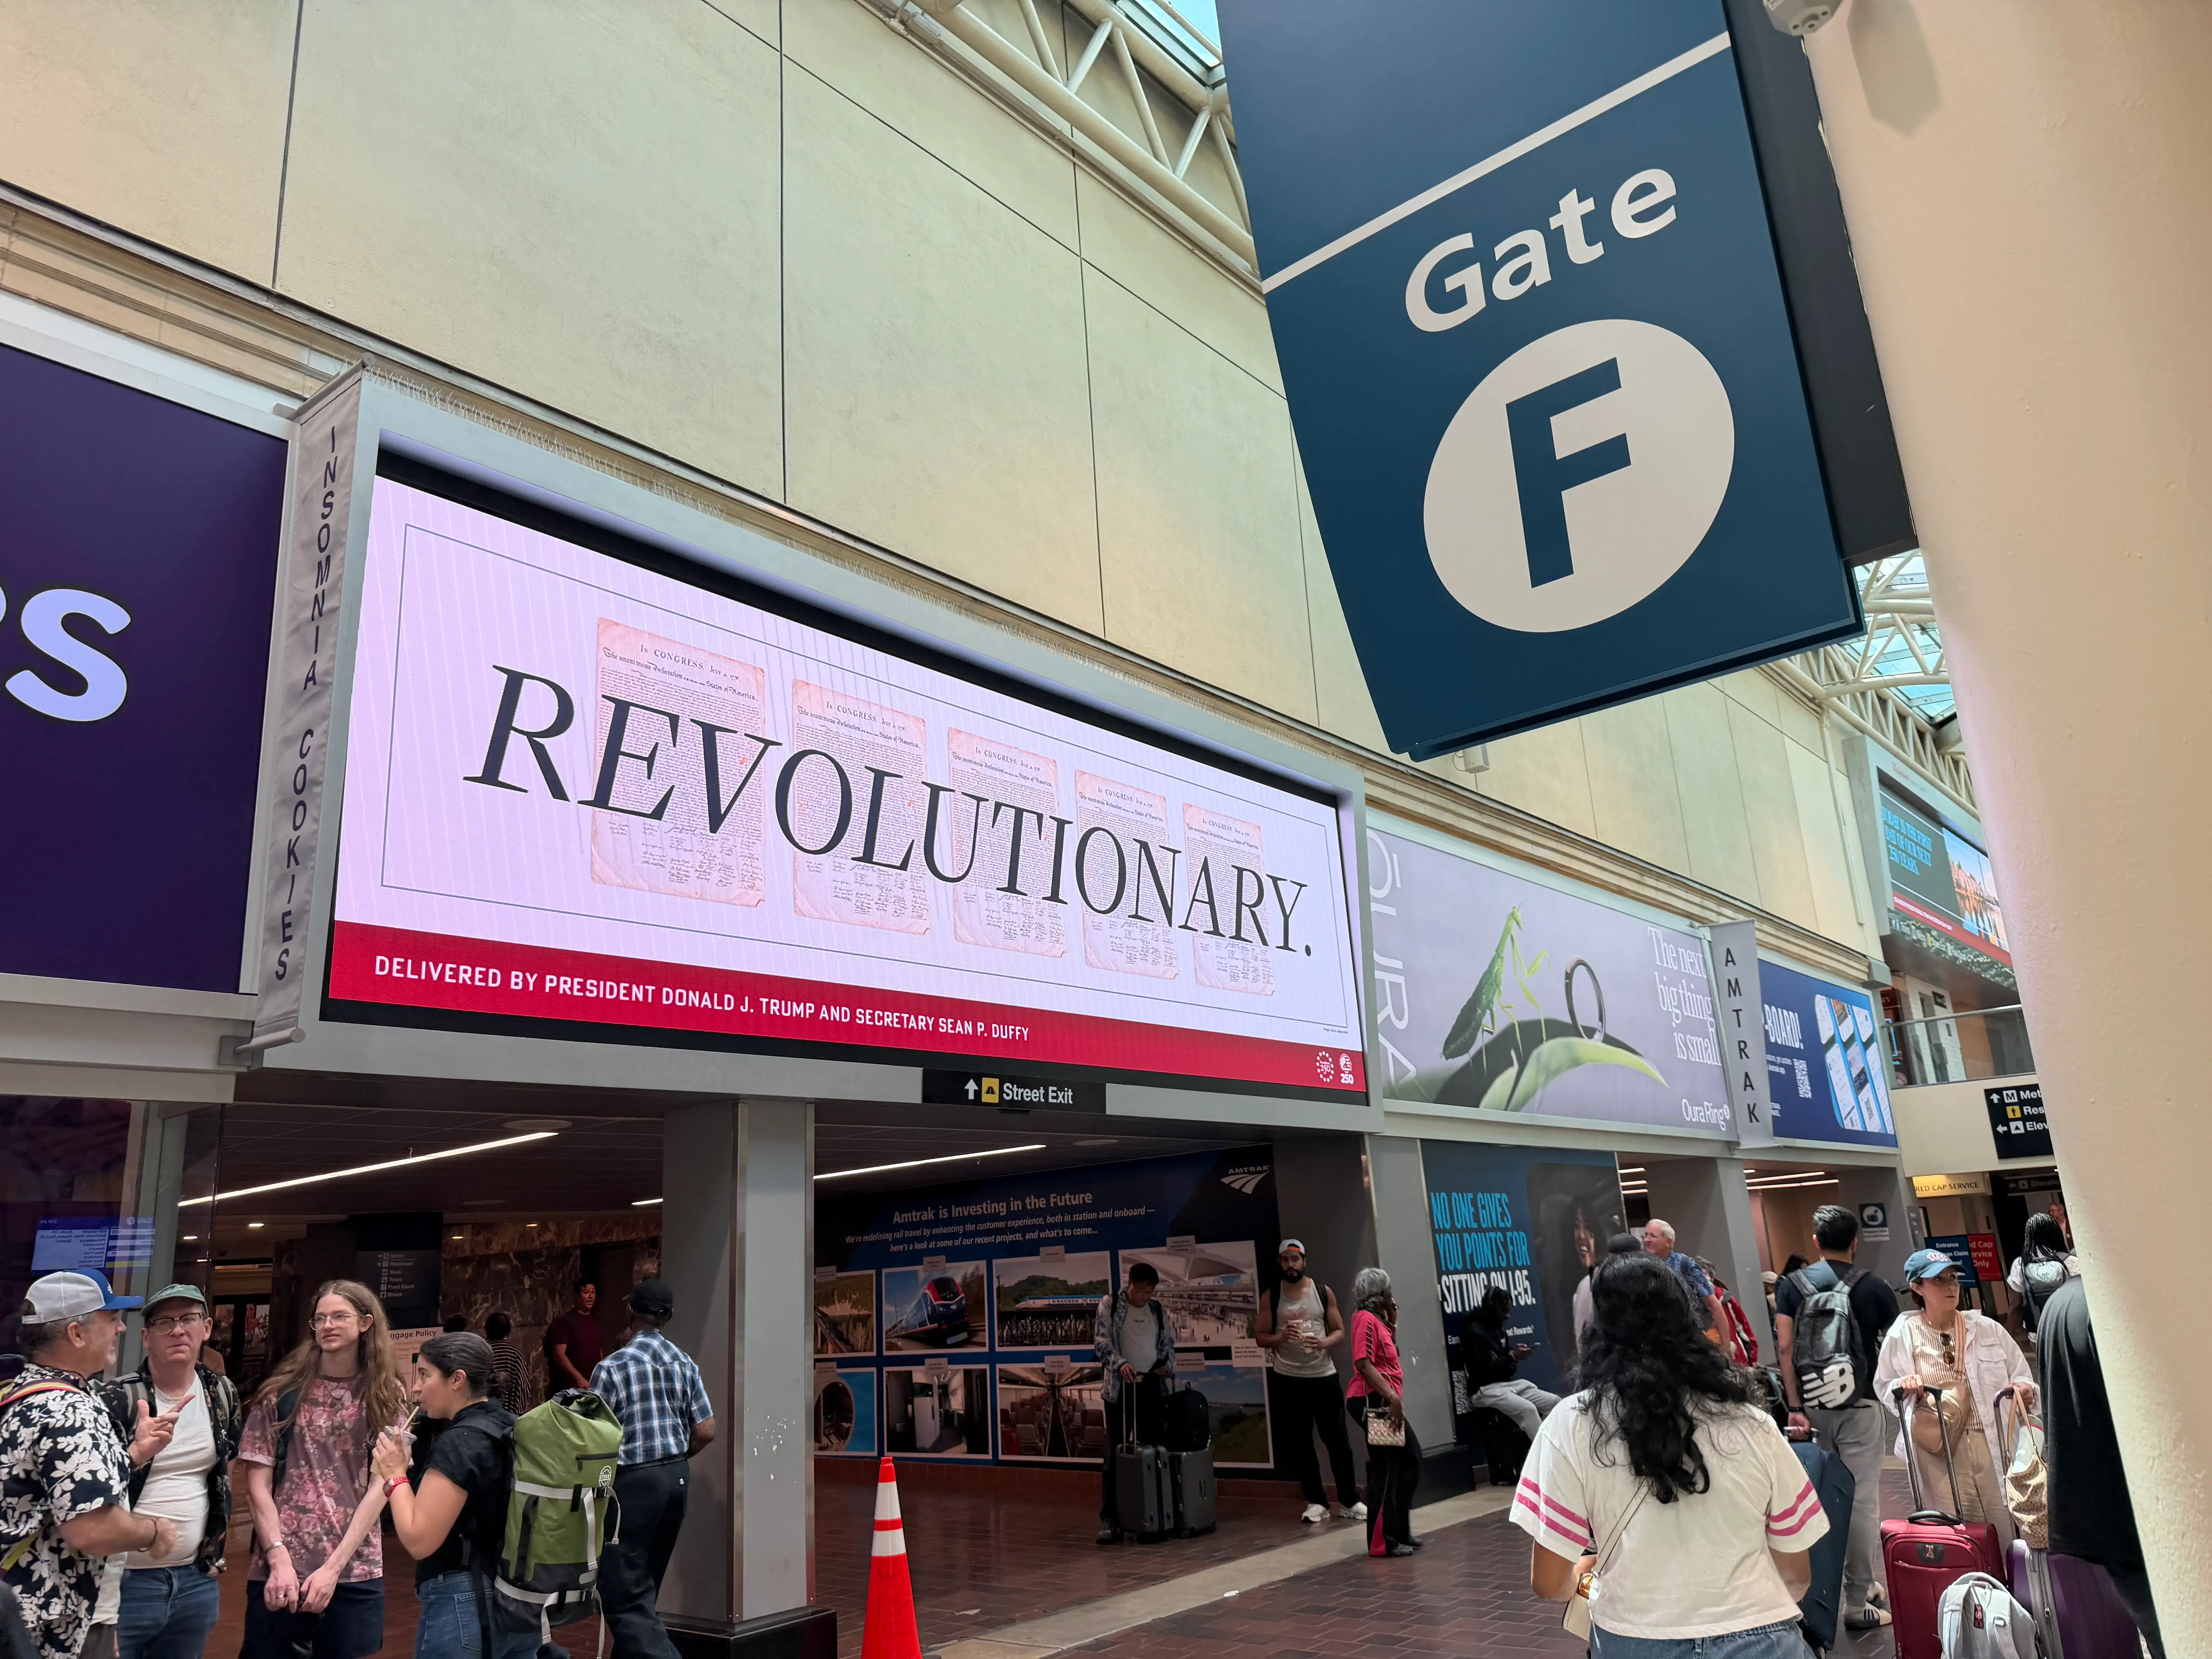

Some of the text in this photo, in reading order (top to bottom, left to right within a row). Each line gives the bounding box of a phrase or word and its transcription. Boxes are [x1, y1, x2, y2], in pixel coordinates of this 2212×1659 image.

[1405, 168, 1677, 333] Gate
[1505, 357, 1632, 589] F
[303, 425, 337, 691] INSOMNIA
[464, 666, 1312, 957] REVOLUTIONARY.
[274, 728, 314, 981] COOKIES
[1648, 926, 1707, 979] The next
[375, 955, 1029, 1041] DELIVERED BY PRESIDENT DONALD J. TRUMP AND SECRETARY SEAN P. DUFFY
[1654, 971, 1716, 1030] big thing
[1673, 1023, 1721, 1066] is small
[1725, 948, 1759, 1123] AMTRAK
[1762, 1004, 1804, 1049] -BOARD!
[1003, 1083, 1073, 1104] Street Exit
[1340, 1073, 1354, 1084] 250
[2020, 1089, 2042, 1099] Met
[1682, 1098, 1726, 1131] Oura Ring
[2023, 1106, 2045, 1115] Res
[2026, 1121, 2049, 1131] Elev
[1228, 1165, 1269, 1174] AMTRAK
[845, 1235, 862, 1243] We're
[863, 1231, 892, 1242] redefining
[893, 1230, 903, 1238] rail
[905, 1228, 922, 1237] travel
[923, 1227, 931, 1237] by
[932, 1223, 963, 1235] enhancing
[965, 1222, 975, 1231] the
[977, 1220, 1006, 1230] customer
[1008, 1216, 1044, 1229] experience,
[1046, 1214, 1063, 1224] both
[1064, 1213, 1071, 1222] in
[1073, 1211, 1097, 1221] station
[1099, 1209, 1113, 1218] and
[1114, 1206, 1146, 1217] onboard
[893, 1192, 1092, 1224] Amtrak is Investing in the Future
[1431, 1192, 1512, 1229] NO ONE GIVES
[890, 1242, 908, 1252] here's
[914, 1241, 927, 1250] look
[937, 1239, 953, 1247] some
[954, 1237, 962, 1246] of
[974, 1235, 994, 1244] recent
[996, 1233, 1024, 1243] projects,
[1025, 1231, 1038, 1240] and
[1039, 1229, 1062, 1238] what's
[1064, 1228, 1071, 1236] to
[1073, 1227, 1097, 1236] come...
[1435, 1231, 1530, 1271] YOU POINTS FOR
[1441, 1272, 1488, 1314] SITTING
[1508, 1269, 1537, 1307] I-95.
